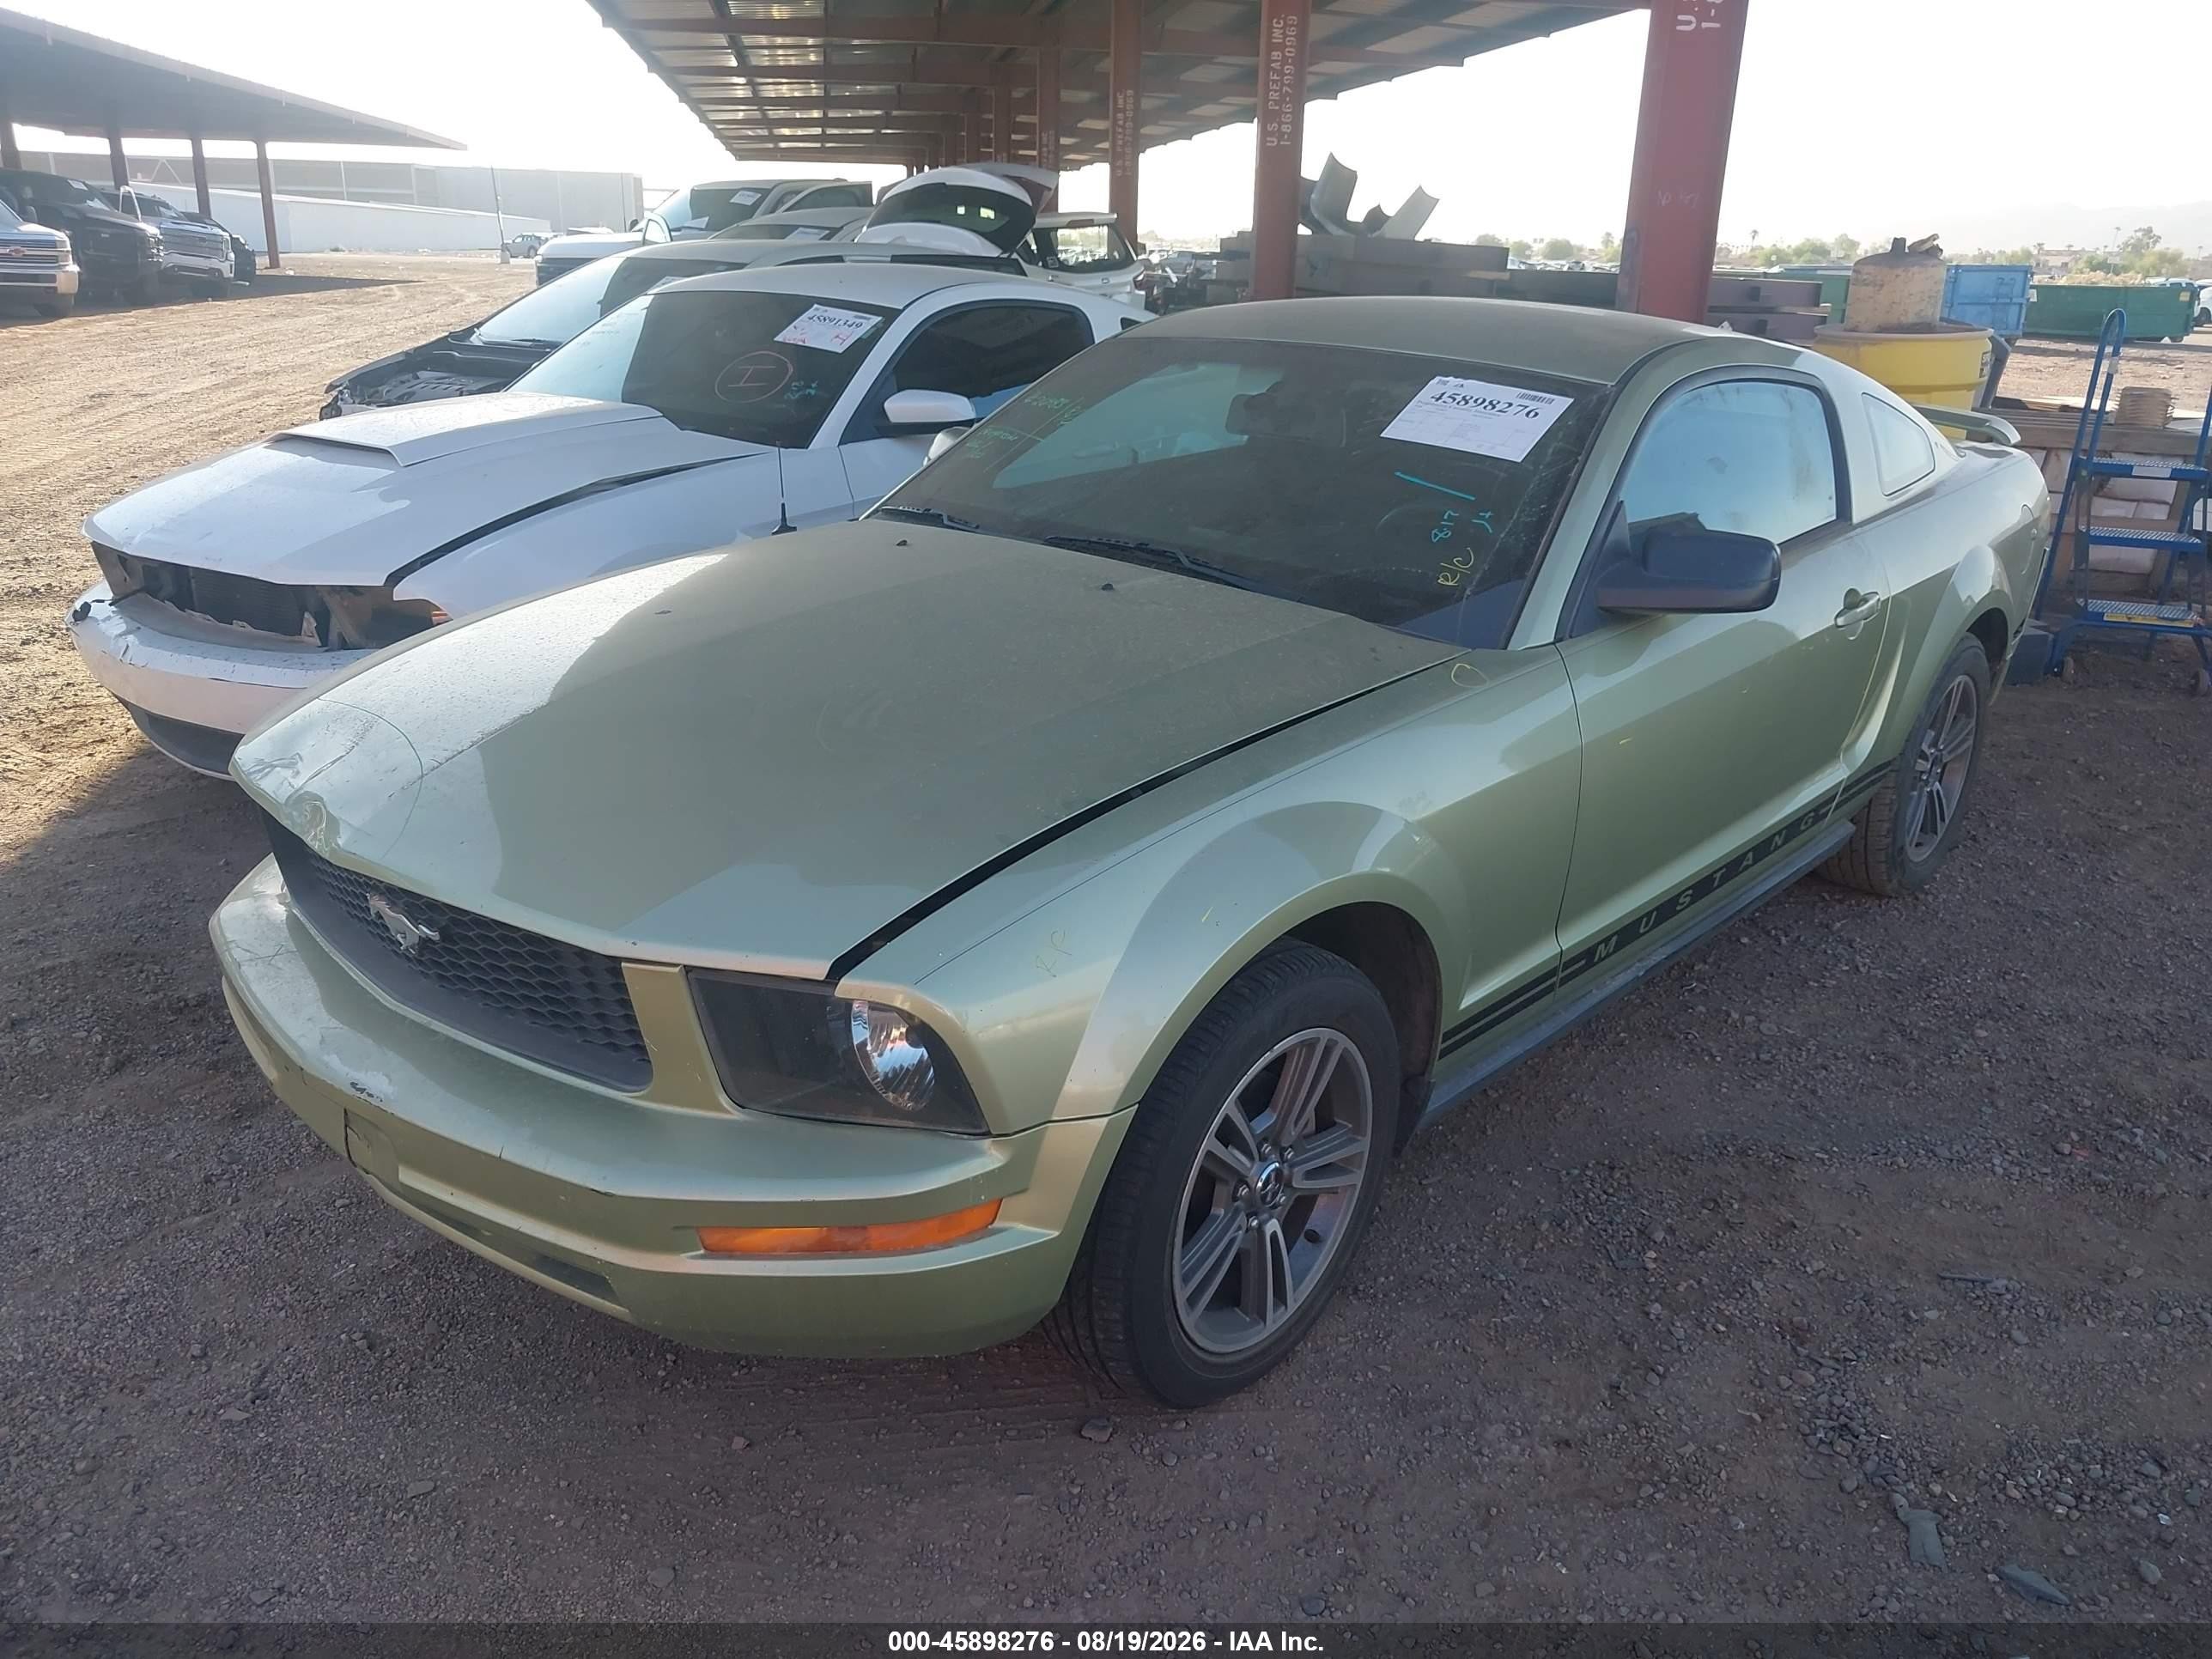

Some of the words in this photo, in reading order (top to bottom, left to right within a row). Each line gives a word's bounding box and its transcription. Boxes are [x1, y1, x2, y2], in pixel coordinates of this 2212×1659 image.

[1268, 51, 1282, 109] PREFAB
[1280, 15, 1298, 145] 1-866-799-0969
[1430, 391, 1540, 420] 45898276
[1595, 813, 1815, 962] MUSTANG
